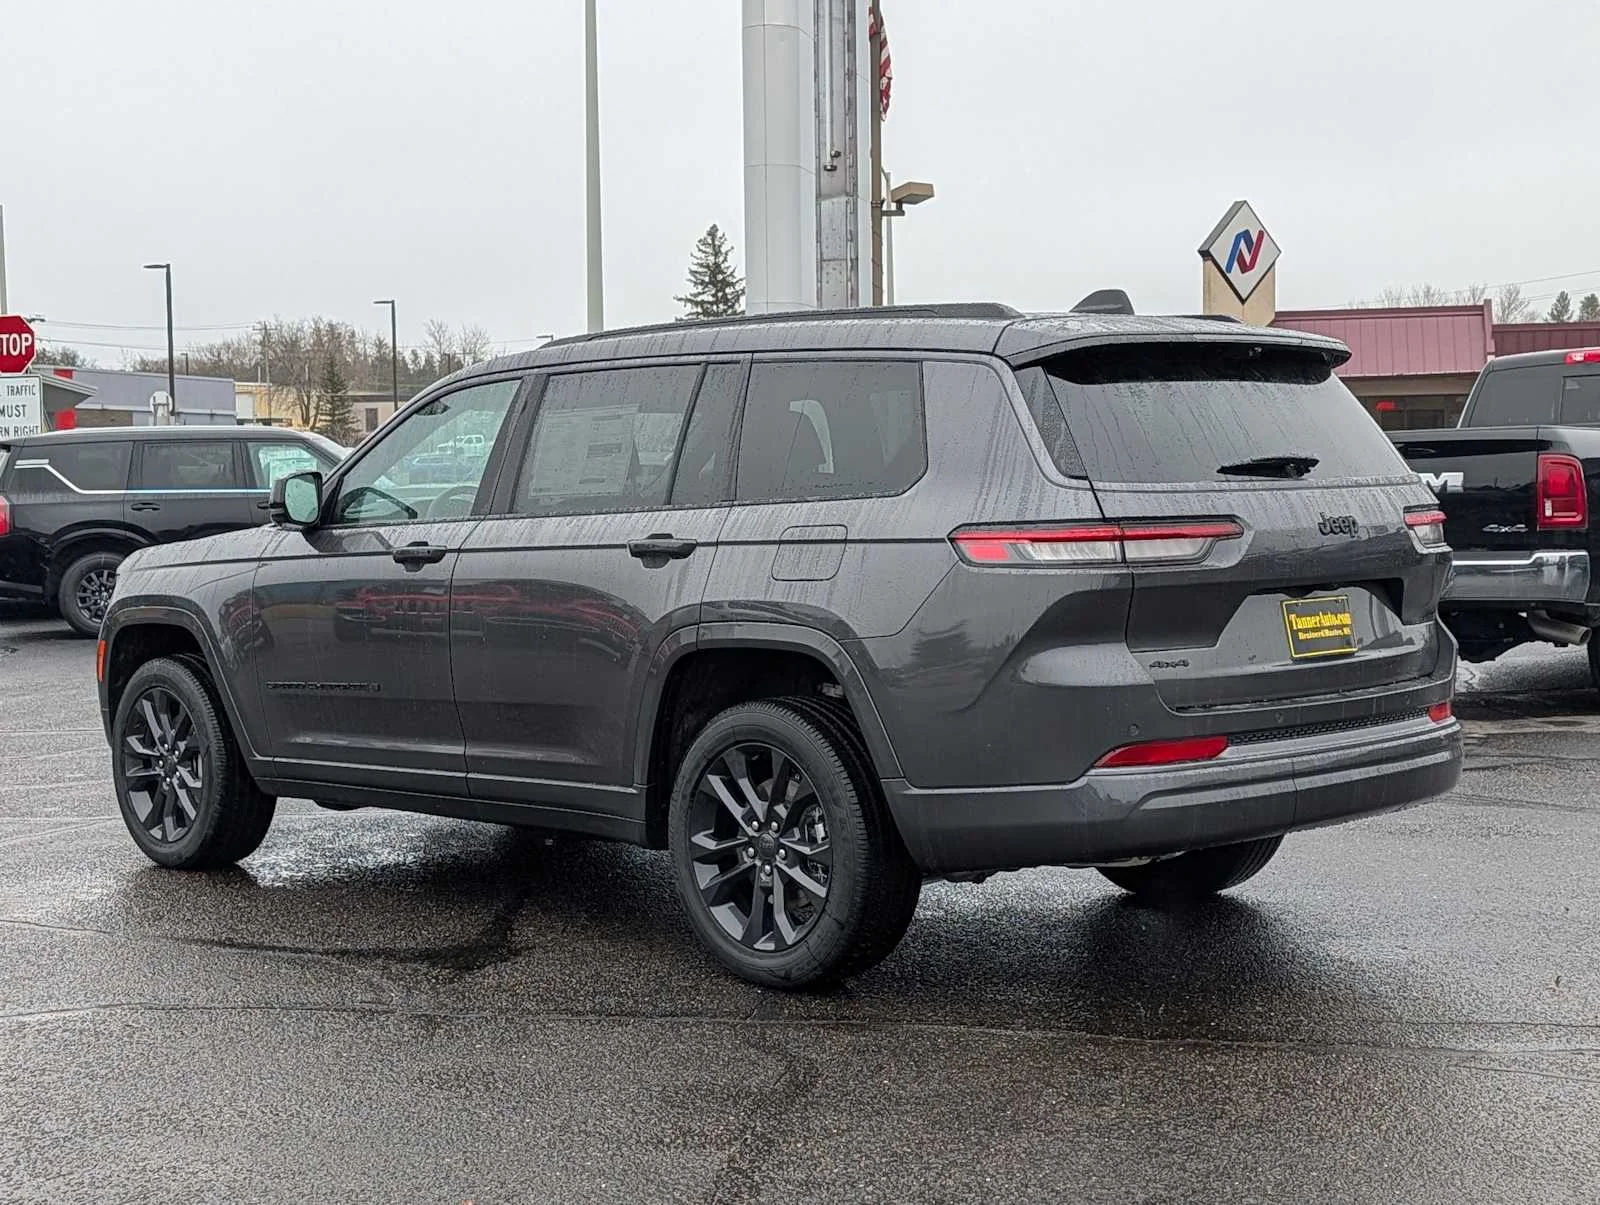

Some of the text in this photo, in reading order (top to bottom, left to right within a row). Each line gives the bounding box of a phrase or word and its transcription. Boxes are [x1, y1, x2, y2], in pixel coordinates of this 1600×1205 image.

[0, 333, 32, 356] TOP
[6, 384, 36, 396] TRAFFIC
[13, 425, 40, 437] RIGHT
[1317, 511, 1359, 539] Jeep
